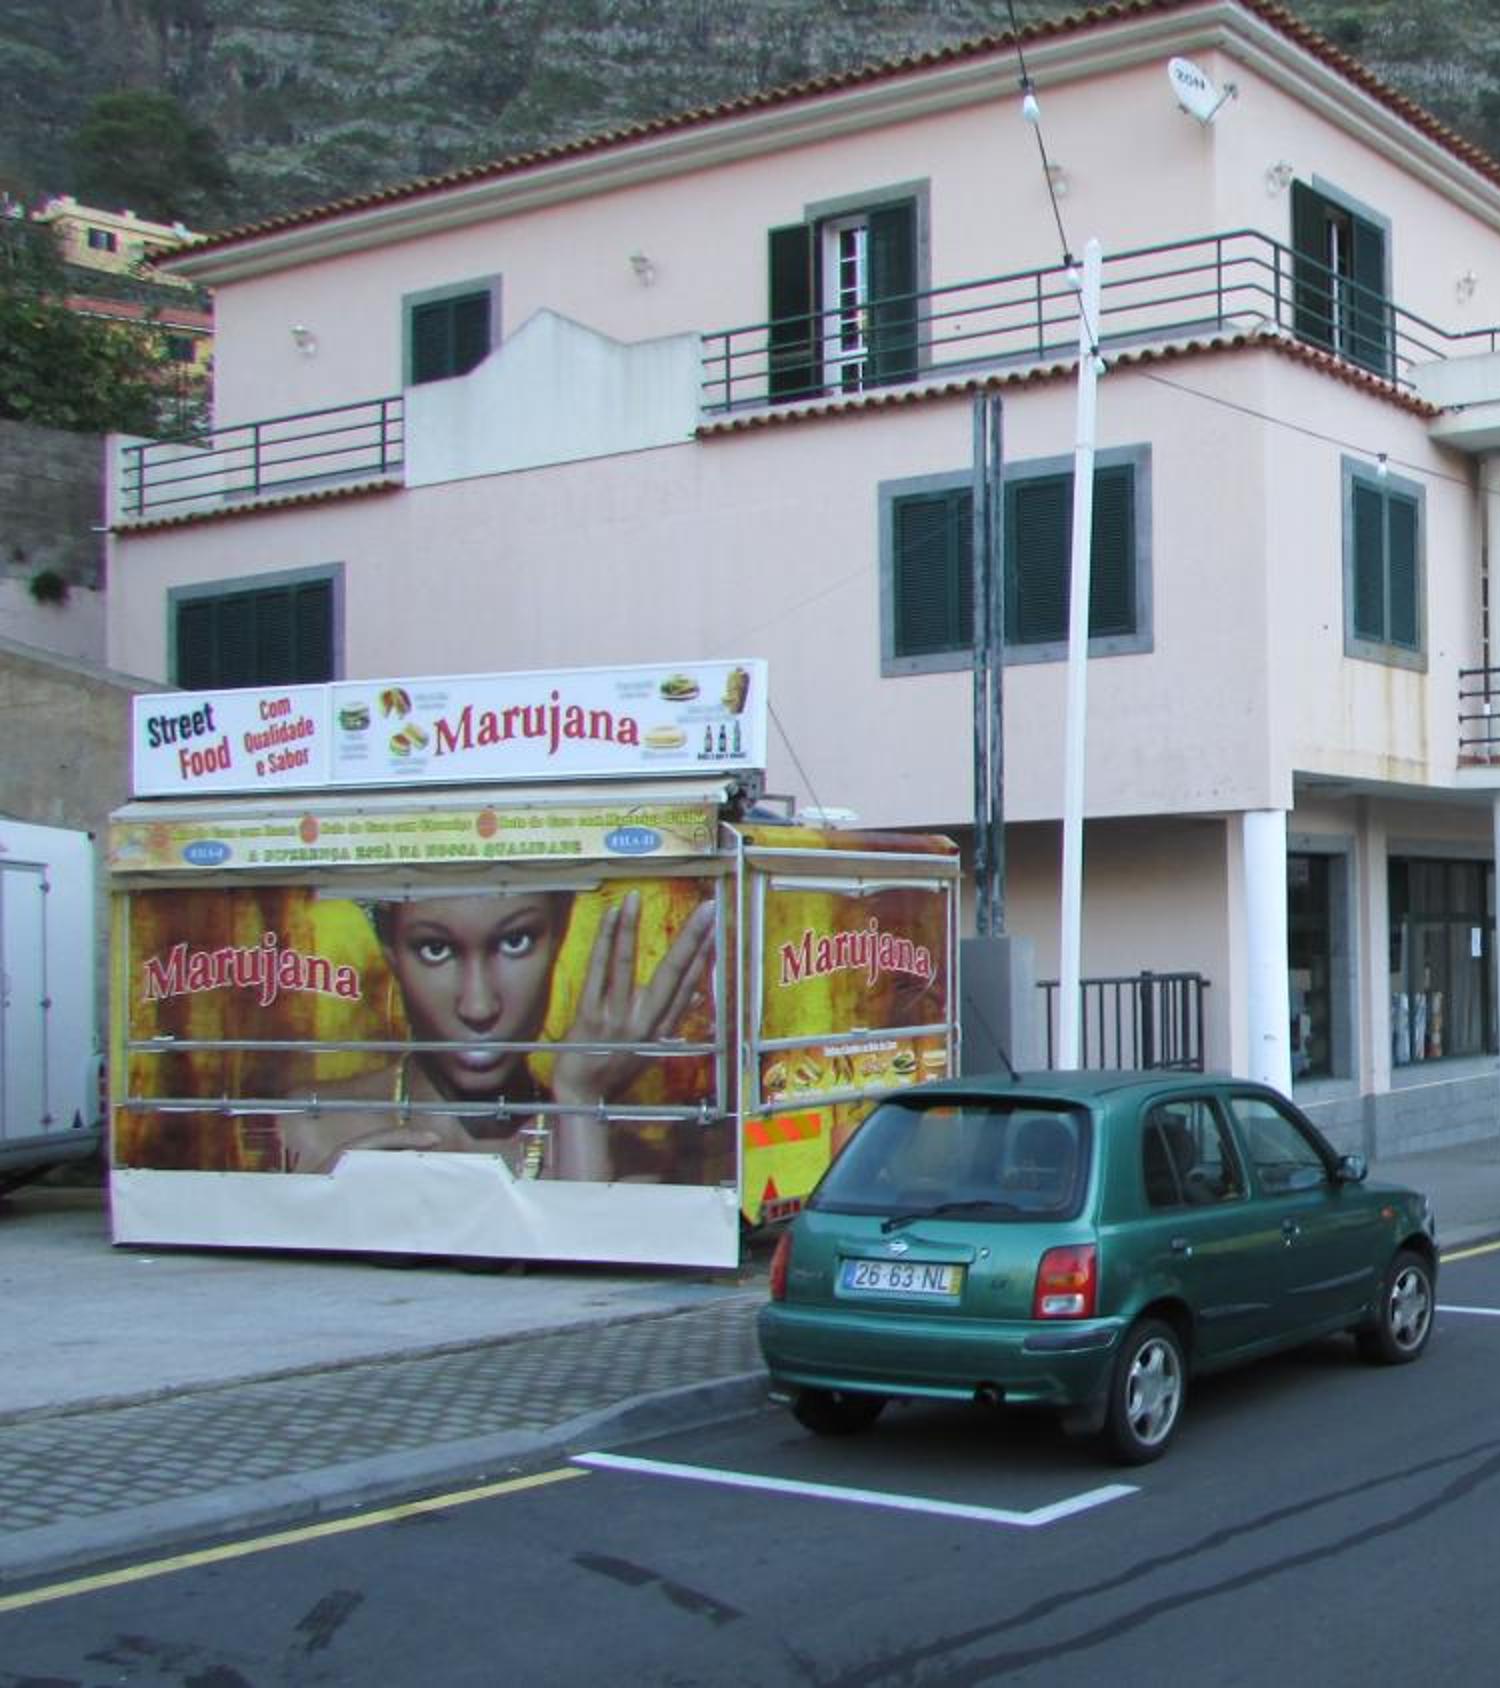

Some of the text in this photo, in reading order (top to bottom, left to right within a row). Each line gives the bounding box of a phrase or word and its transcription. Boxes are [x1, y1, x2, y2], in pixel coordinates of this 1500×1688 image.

[147, 702, 216, 748] Street
[258, 697, 292, 721] Com
[432, 689, 640, 757] Marujana
[243, 716, 315, 753] Qualidade
[178, 736, 231, 780] Food
[255, 746, 310, 777] e Sabor
[142, 931, 362, 1007] Marujana
[779, 917, 932, 987] Marujana
